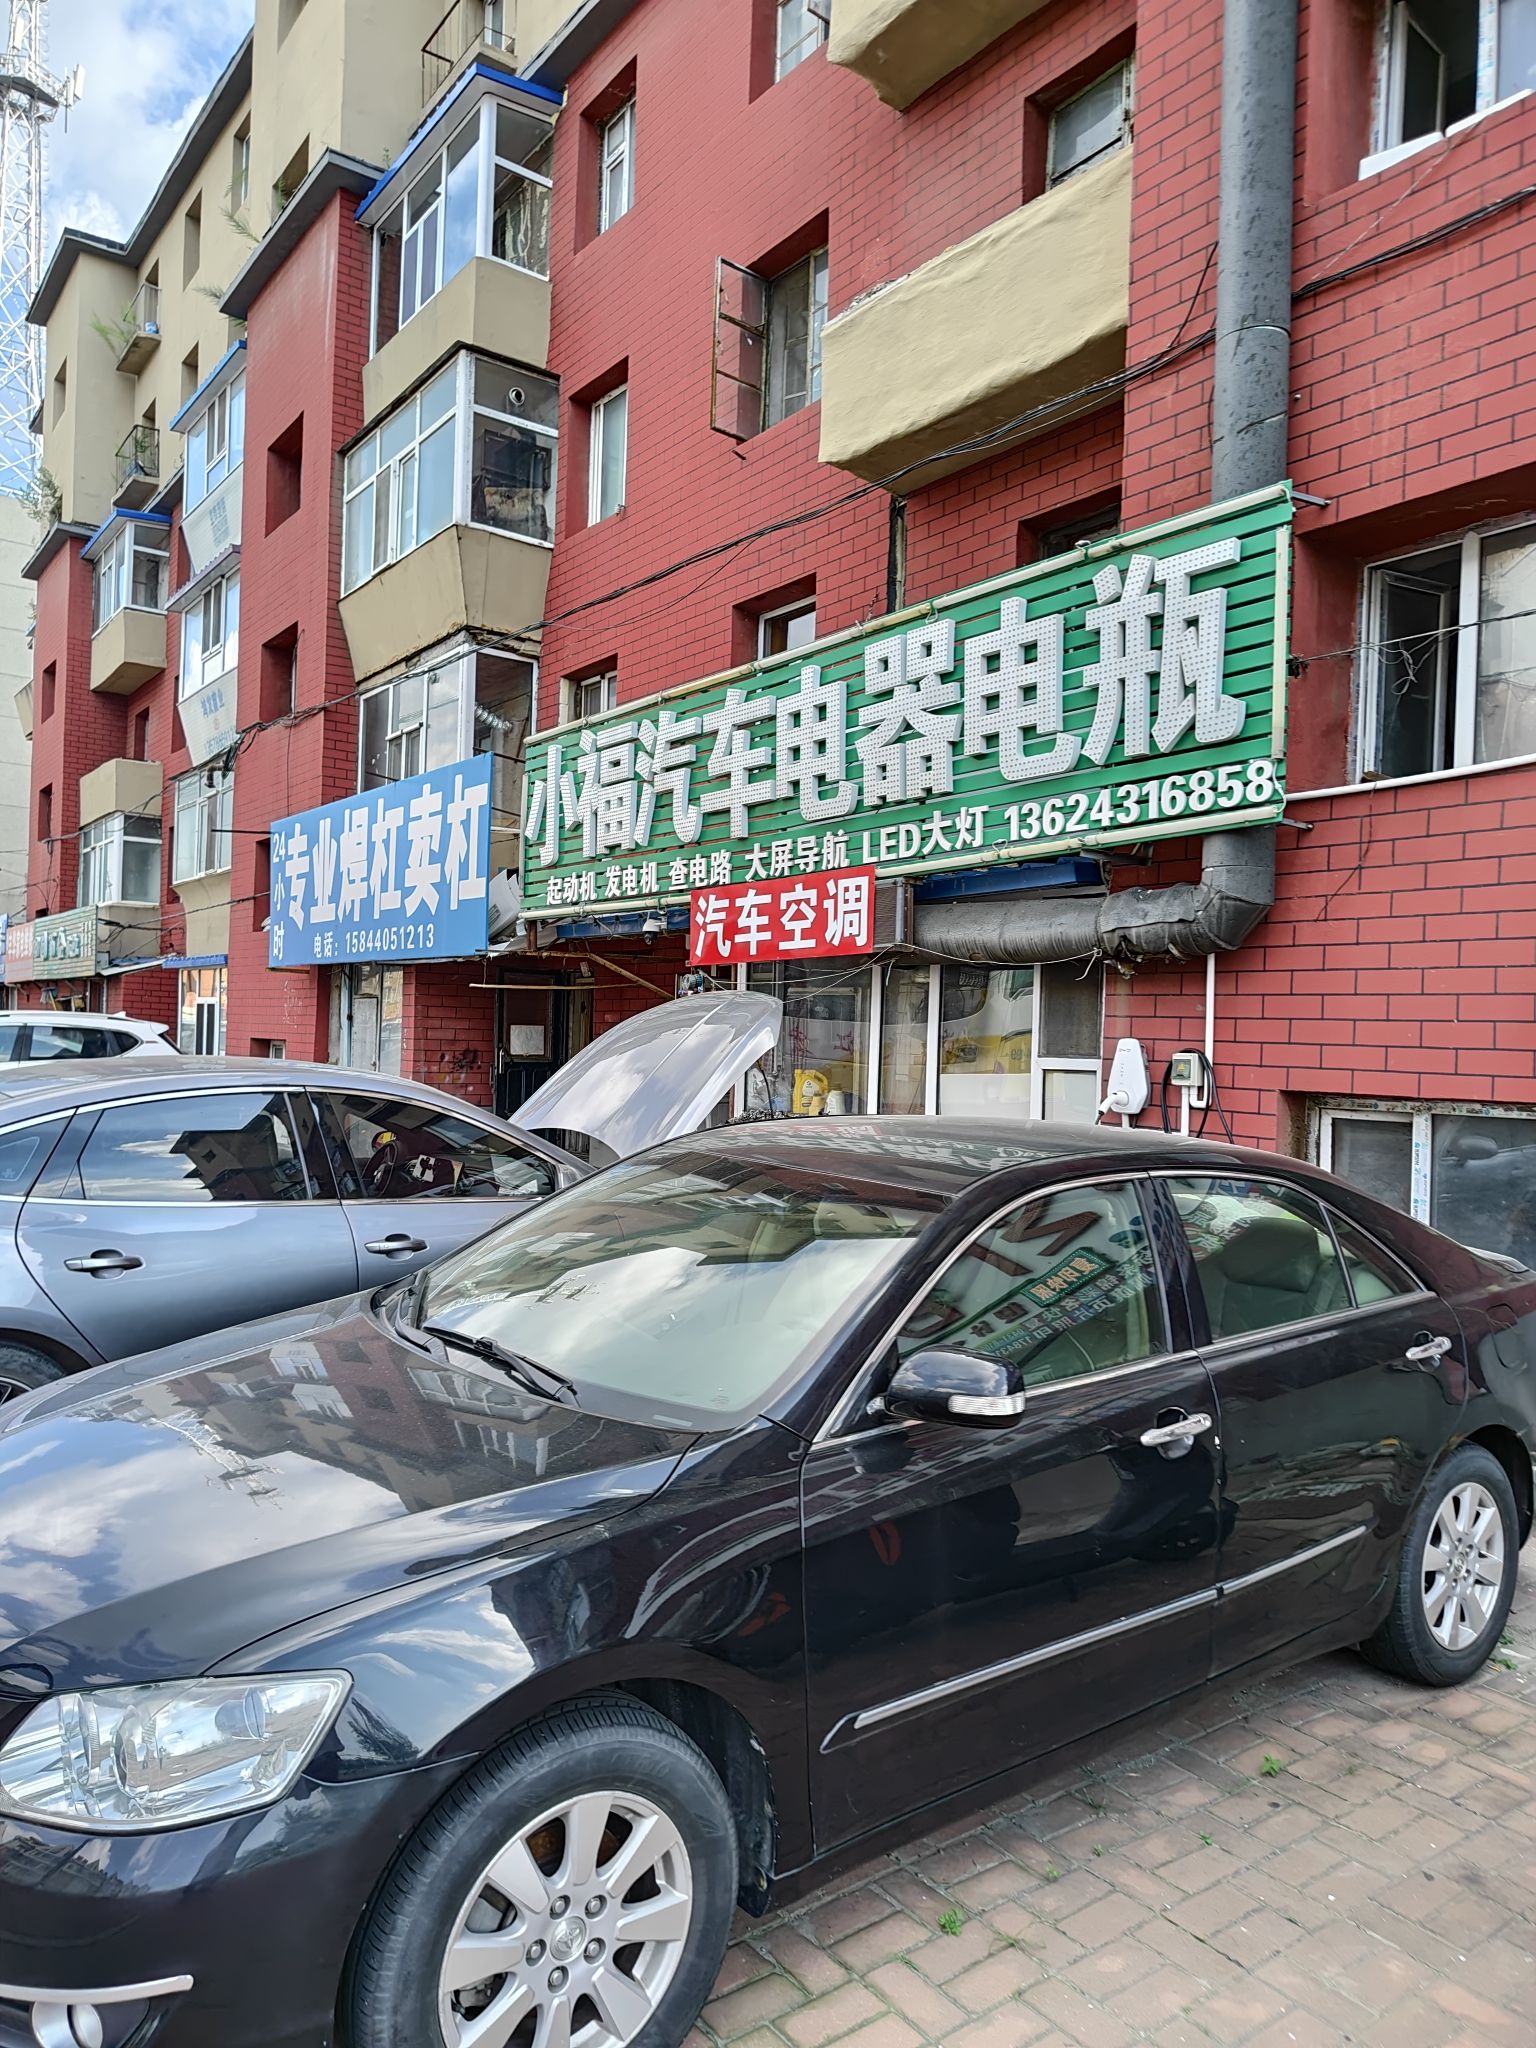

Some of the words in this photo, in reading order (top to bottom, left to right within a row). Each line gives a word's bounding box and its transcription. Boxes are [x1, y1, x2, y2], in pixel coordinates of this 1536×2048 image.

[524, 536, 1248, 866] 小福汽车电器电瓶
[272, 832, 286, 961] 24小时
[285, 775, 488, 931] 专业焊杠卖杠
[546, 872, 598, 906] 起动机
[604, 862, 659, 894] 发电机
[668, 850, 732, 890] 查电路
[744, 828, 850, 881] 大屏导航
[862, 804, 984, 860] LED大灯
[1003, 759, 1275, 840] 13624316858
[694, 875, 870, 959] 汽车空调
